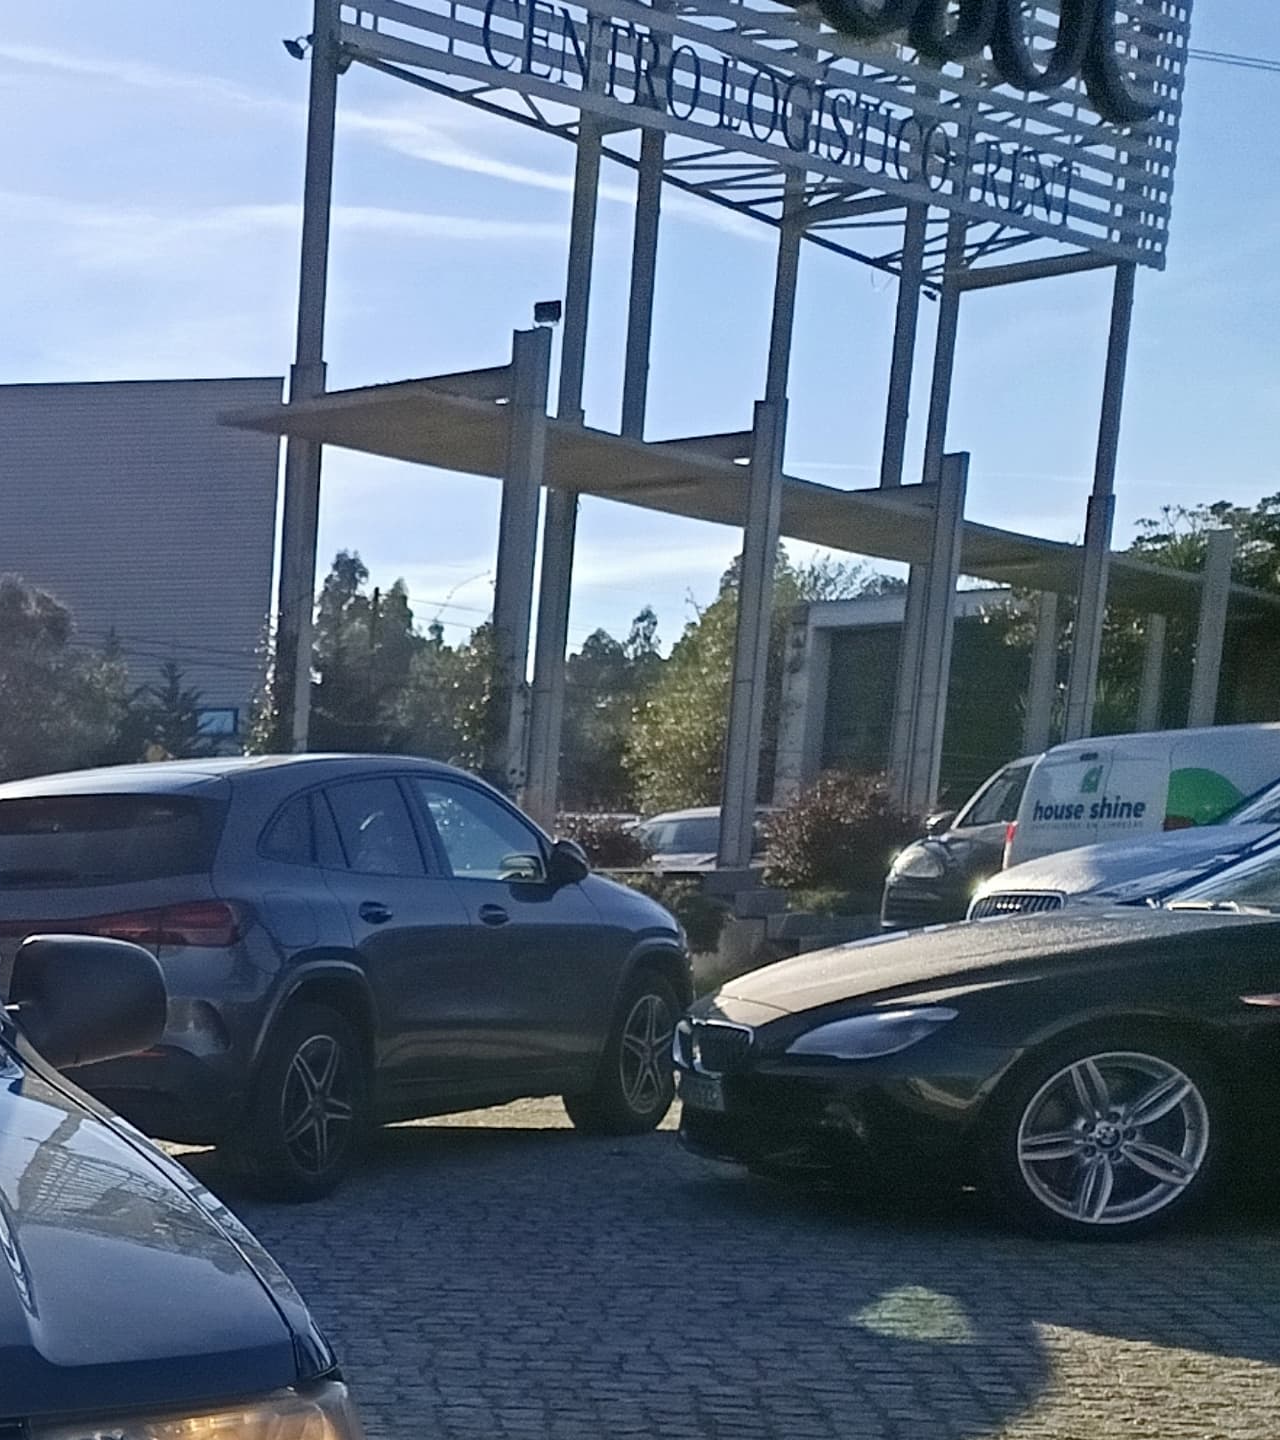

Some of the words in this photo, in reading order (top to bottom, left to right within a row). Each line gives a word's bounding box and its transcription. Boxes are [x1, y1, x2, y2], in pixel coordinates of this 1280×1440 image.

[482, 0, 701, 121] CENTRO
[1032, 799, 1085, 821] house
[1089, 795, 1146, 819] shine
